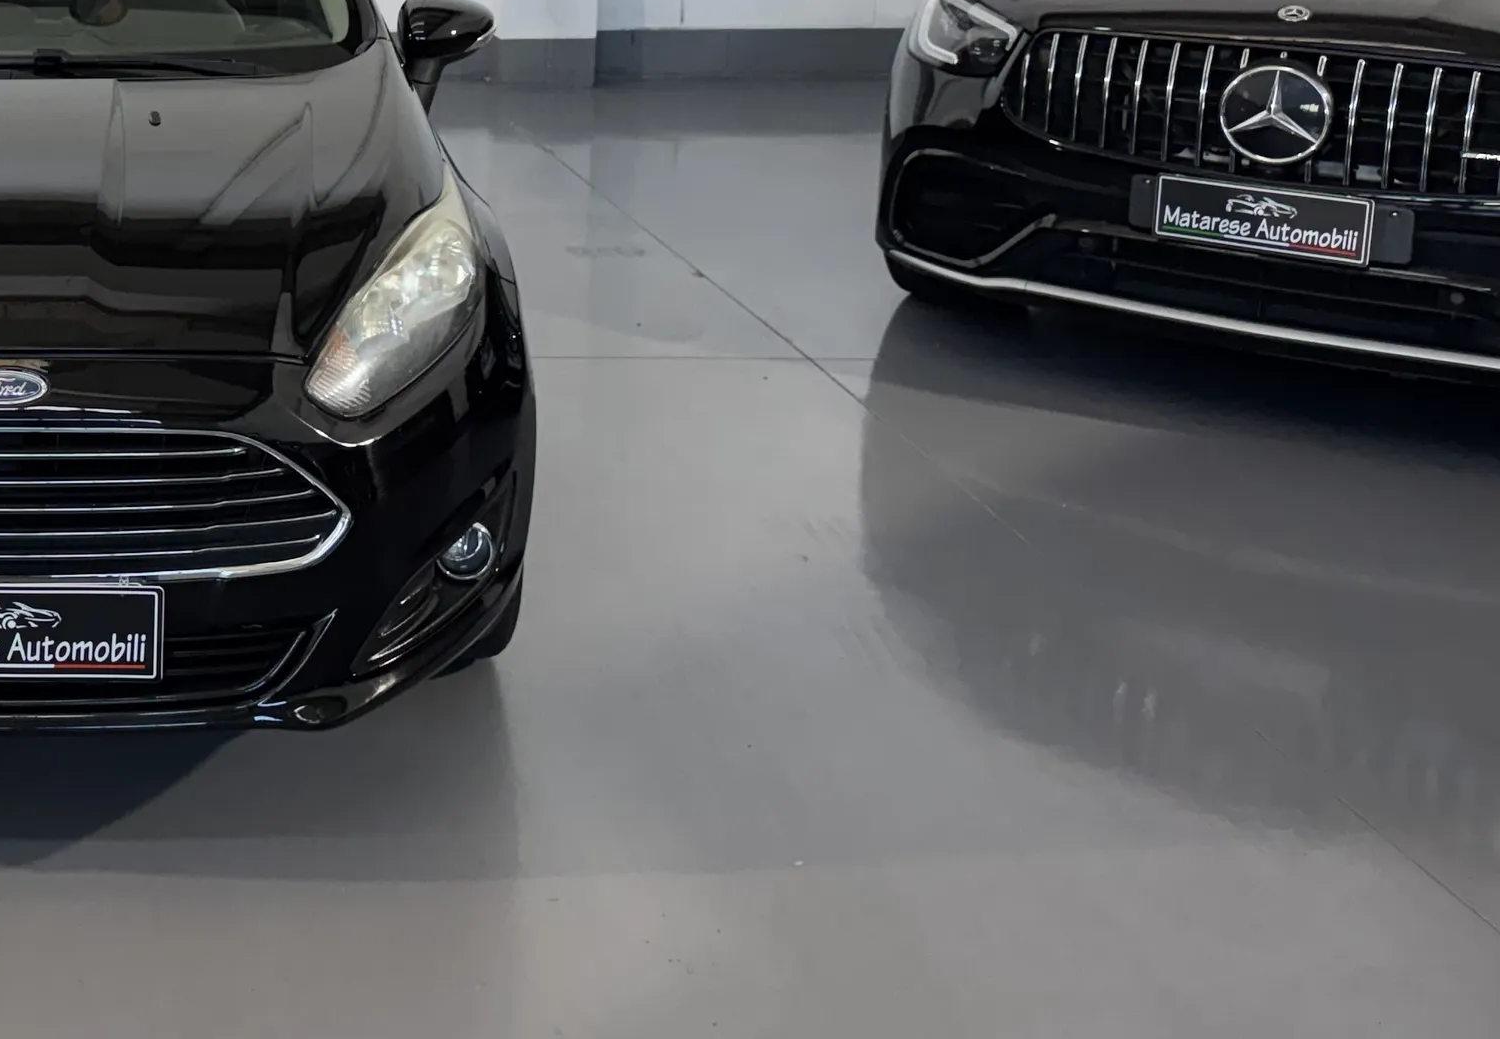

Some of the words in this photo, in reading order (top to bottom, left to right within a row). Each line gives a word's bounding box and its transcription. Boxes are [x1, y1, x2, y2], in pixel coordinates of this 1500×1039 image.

[1163, 205, 1251, 236] Matarese
[1255, 218, 1358, 251] Automobili
[7, 632, 147, 663] Automobili
